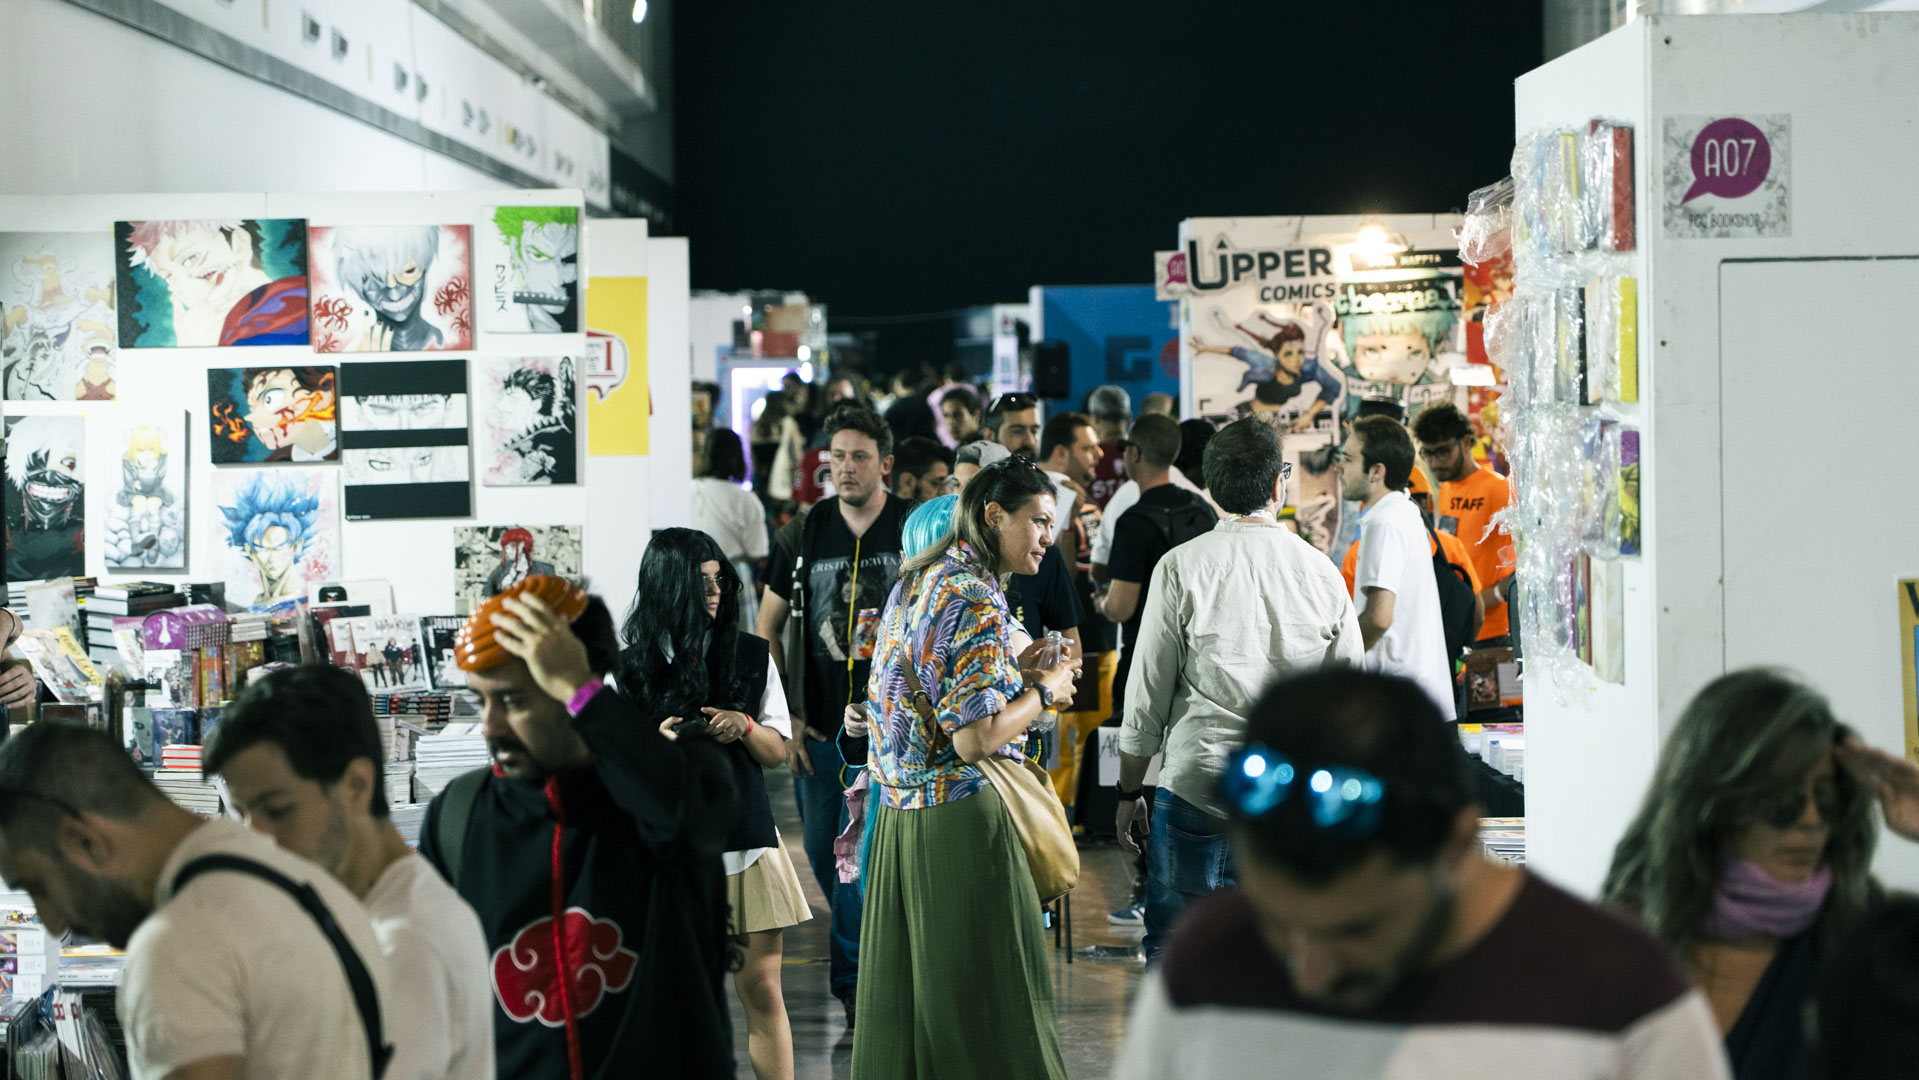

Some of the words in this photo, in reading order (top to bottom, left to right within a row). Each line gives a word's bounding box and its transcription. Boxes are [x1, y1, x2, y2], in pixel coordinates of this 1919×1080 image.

[1704, 138, 1757, 177] A07
[1710, 213, 1762, 230] BOOKSHOP
[1189, 239, 1333, 290] UPPER
[1260, 284, 1335, 302] COMICS
[1450, 497, 1485, 511] STAFF
[861, 556, 901, 569] D'AVEN
